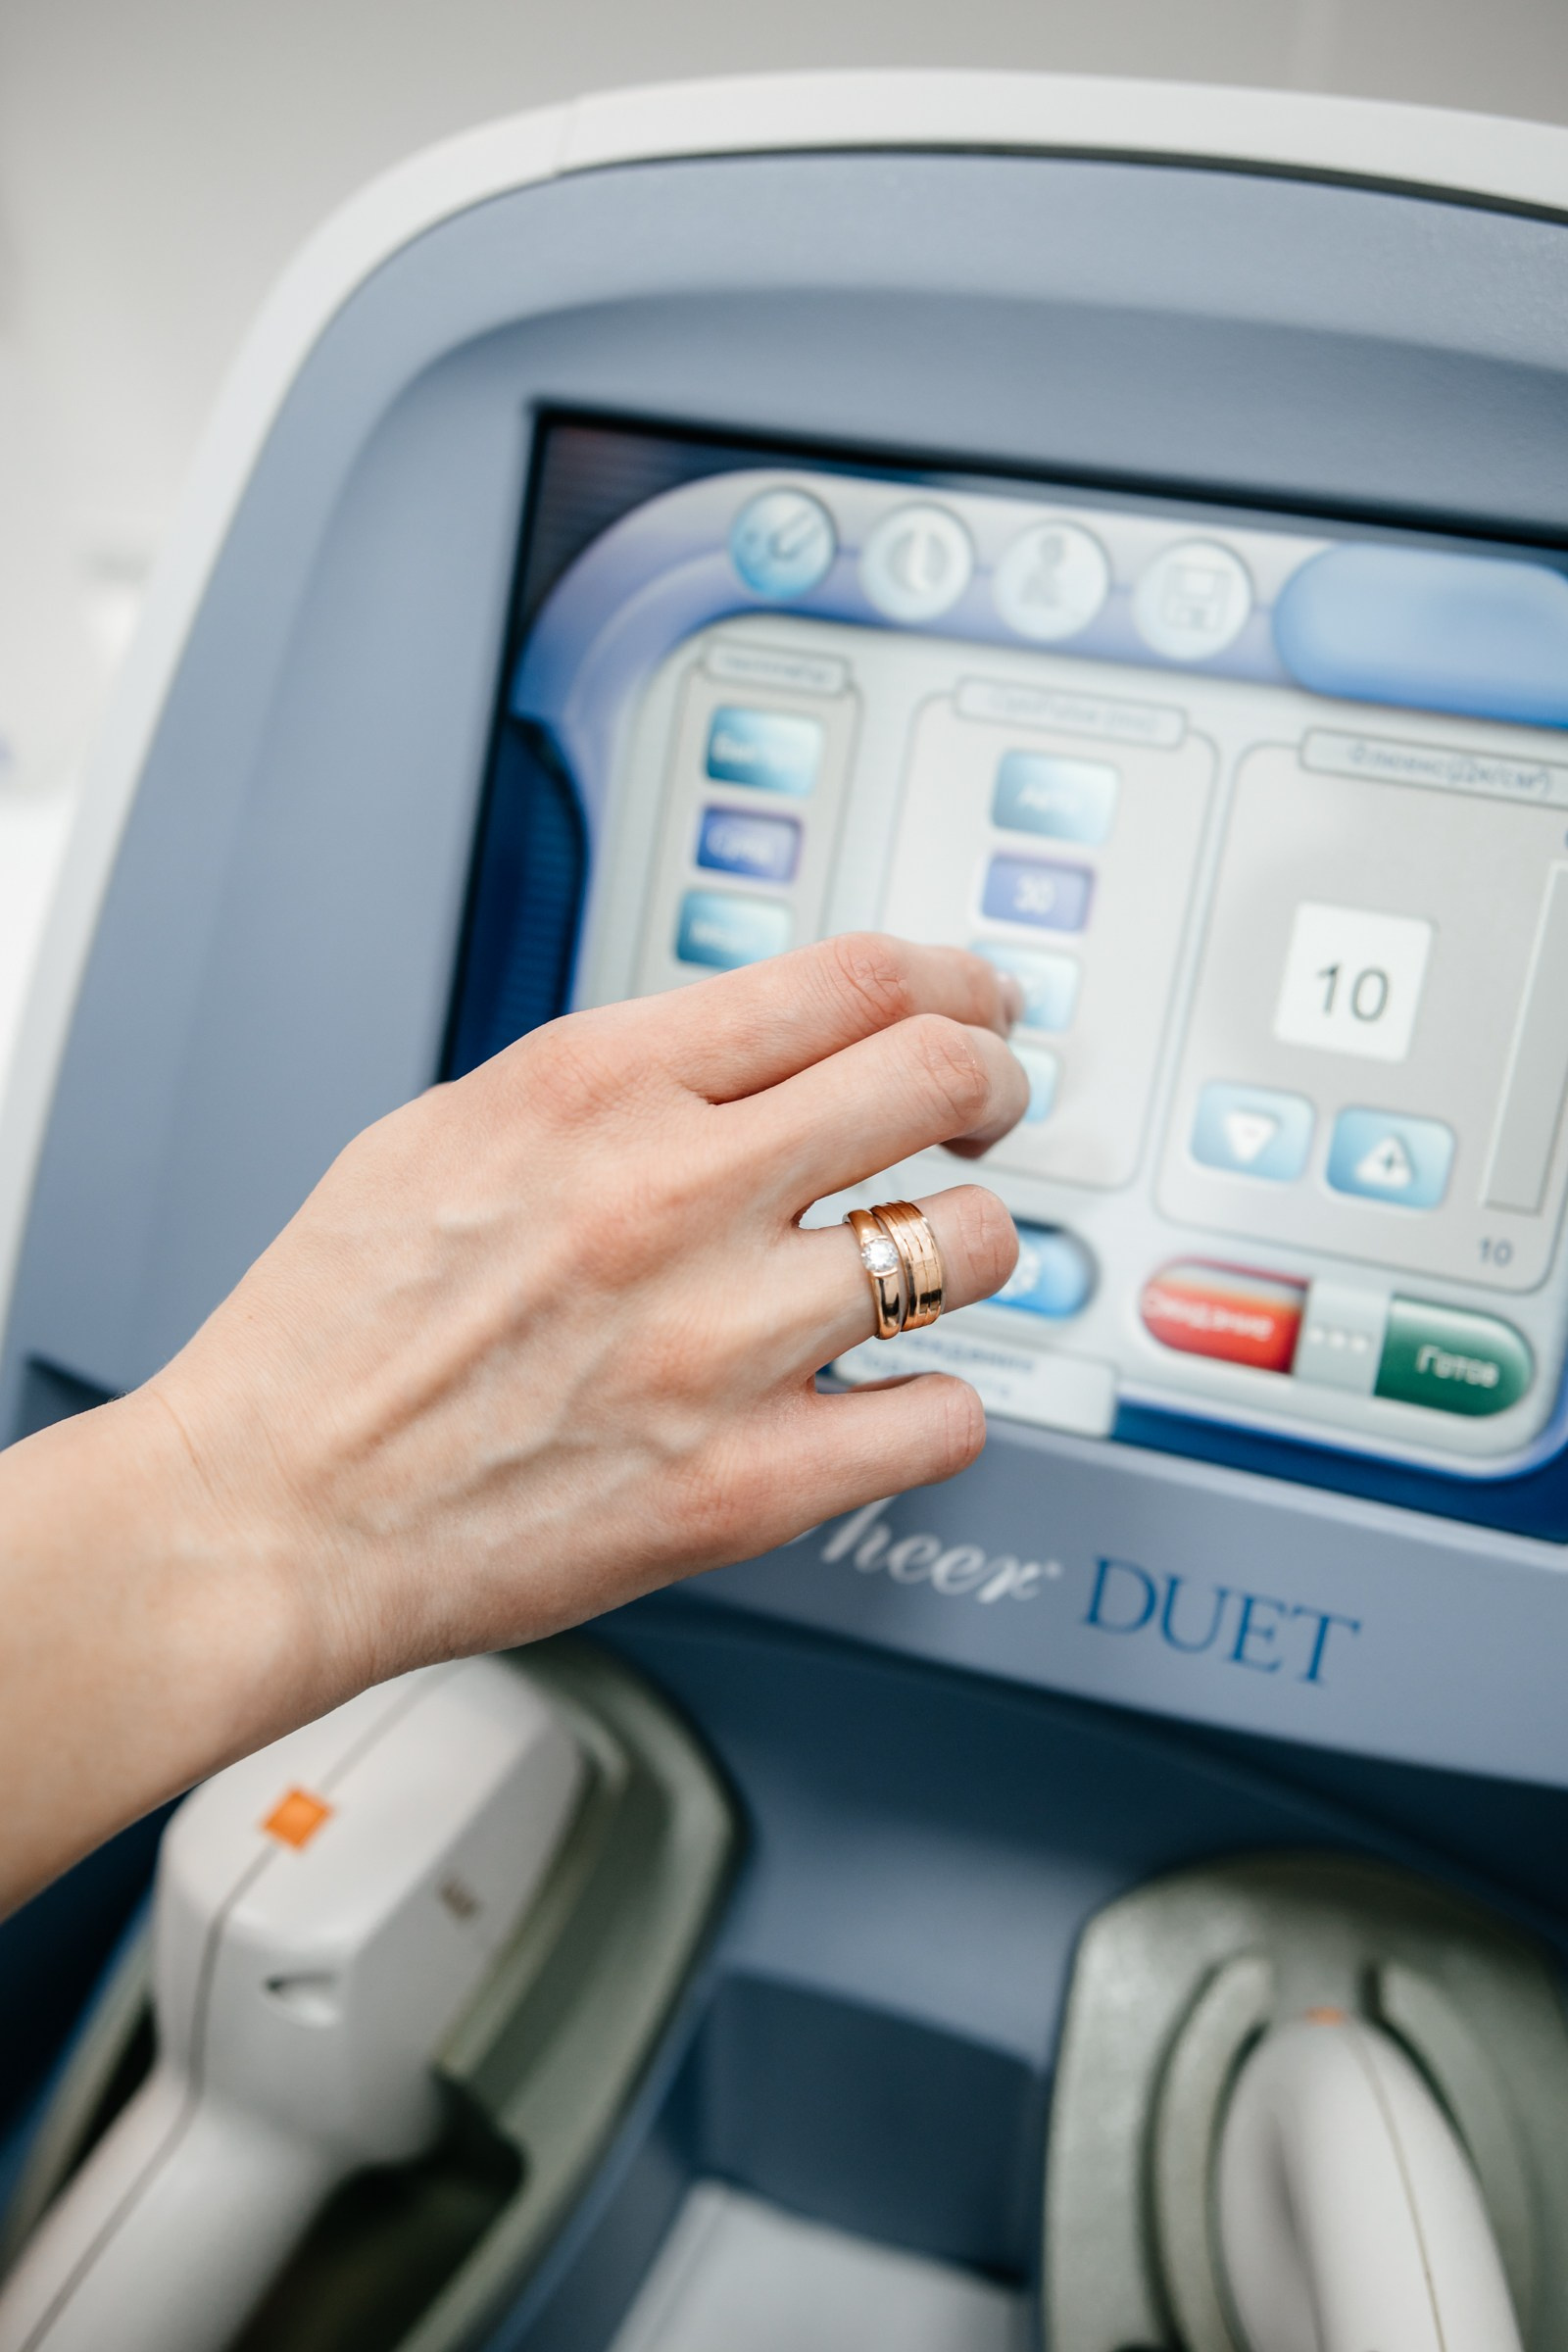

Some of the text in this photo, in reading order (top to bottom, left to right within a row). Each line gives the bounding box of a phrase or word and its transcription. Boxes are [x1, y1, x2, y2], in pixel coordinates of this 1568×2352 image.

[1316, 959, 1392, 1023] 10
[1479, 1236, 1513, 1267] 10
[1416, 1344, 1500, 1390] Готов
[818, 1494, 1362, 1688] heer DUET
